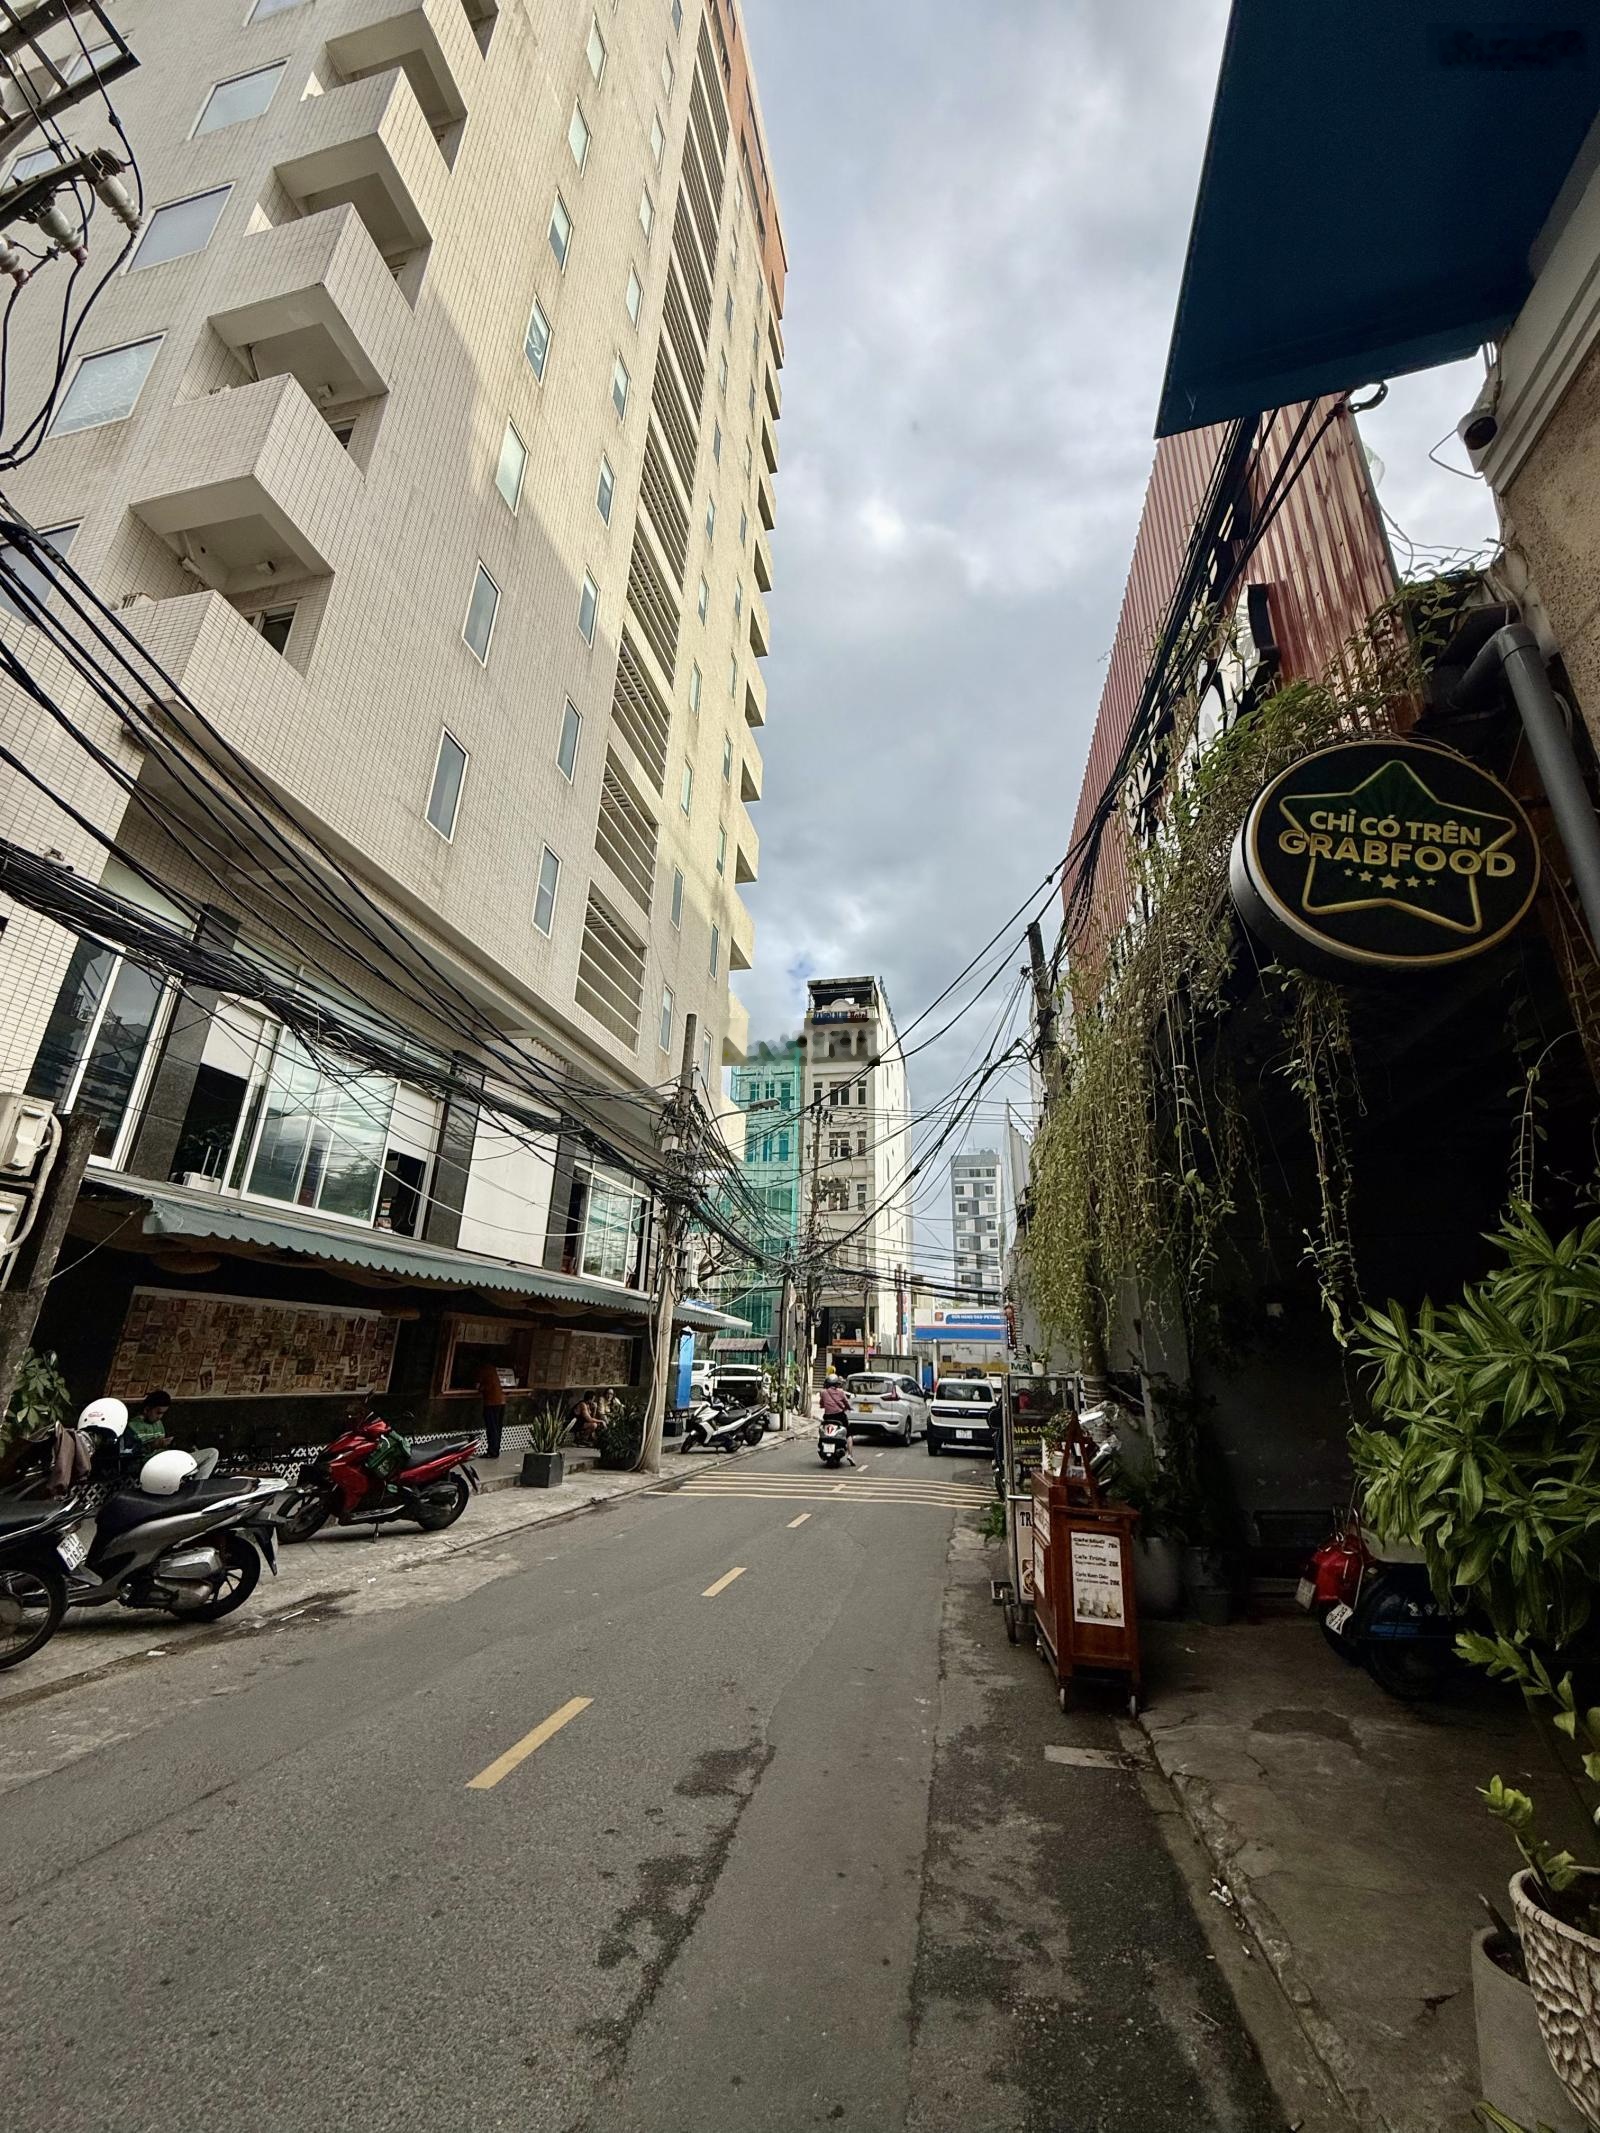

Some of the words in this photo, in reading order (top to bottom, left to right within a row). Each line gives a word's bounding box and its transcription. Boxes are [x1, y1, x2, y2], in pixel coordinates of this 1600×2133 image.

[1309, 808, 1357, 833] CHỈ
[1360, 814, 1401, 838] CÓ
[1405, 820, 1481, 846] TRÊN
[1278, 829, 1516, 877] GRABFOOD
